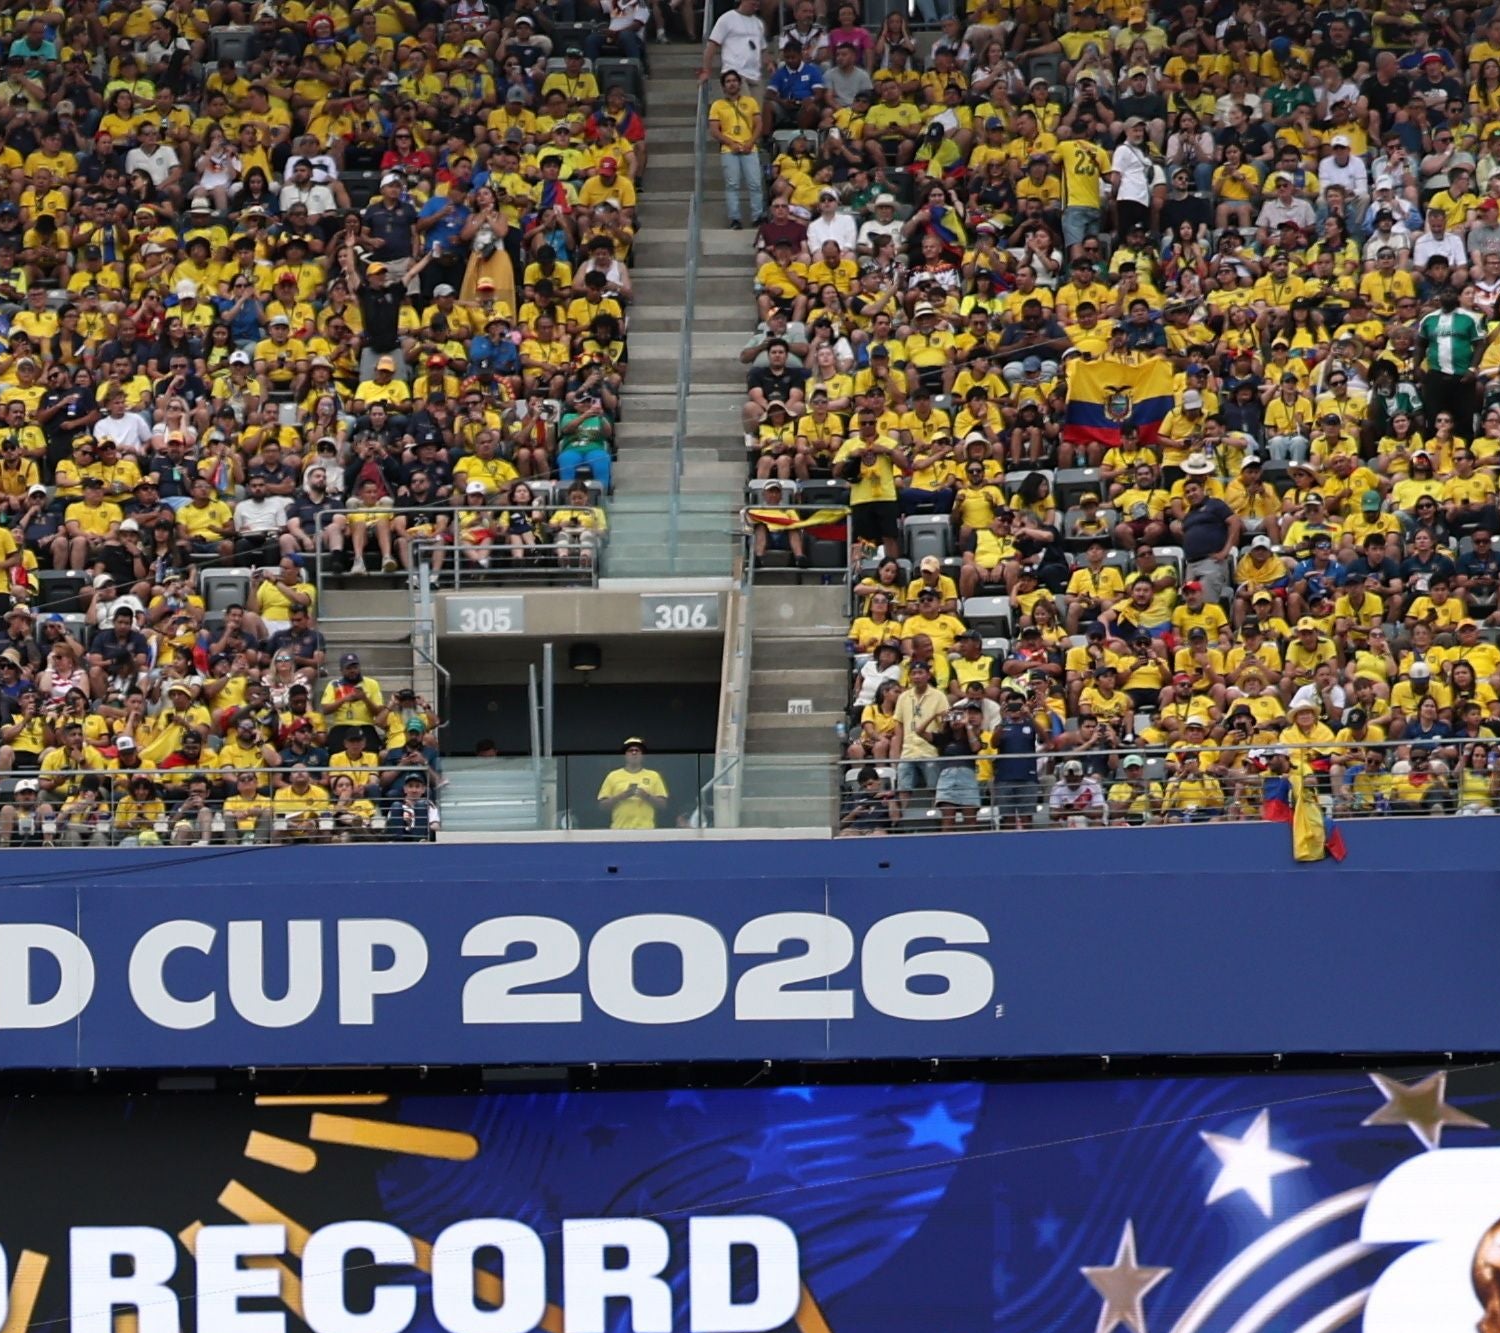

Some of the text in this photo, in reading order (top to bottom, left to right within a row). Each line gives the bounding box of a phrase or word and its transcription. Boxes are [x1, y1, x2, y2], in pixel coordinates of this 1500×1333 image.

[459, 606, 512, 634] 305
[654, 603, 708, 631] 306
[127, 917, 430, 1031] CUP
[459, 909, 995, 1025] 2026
